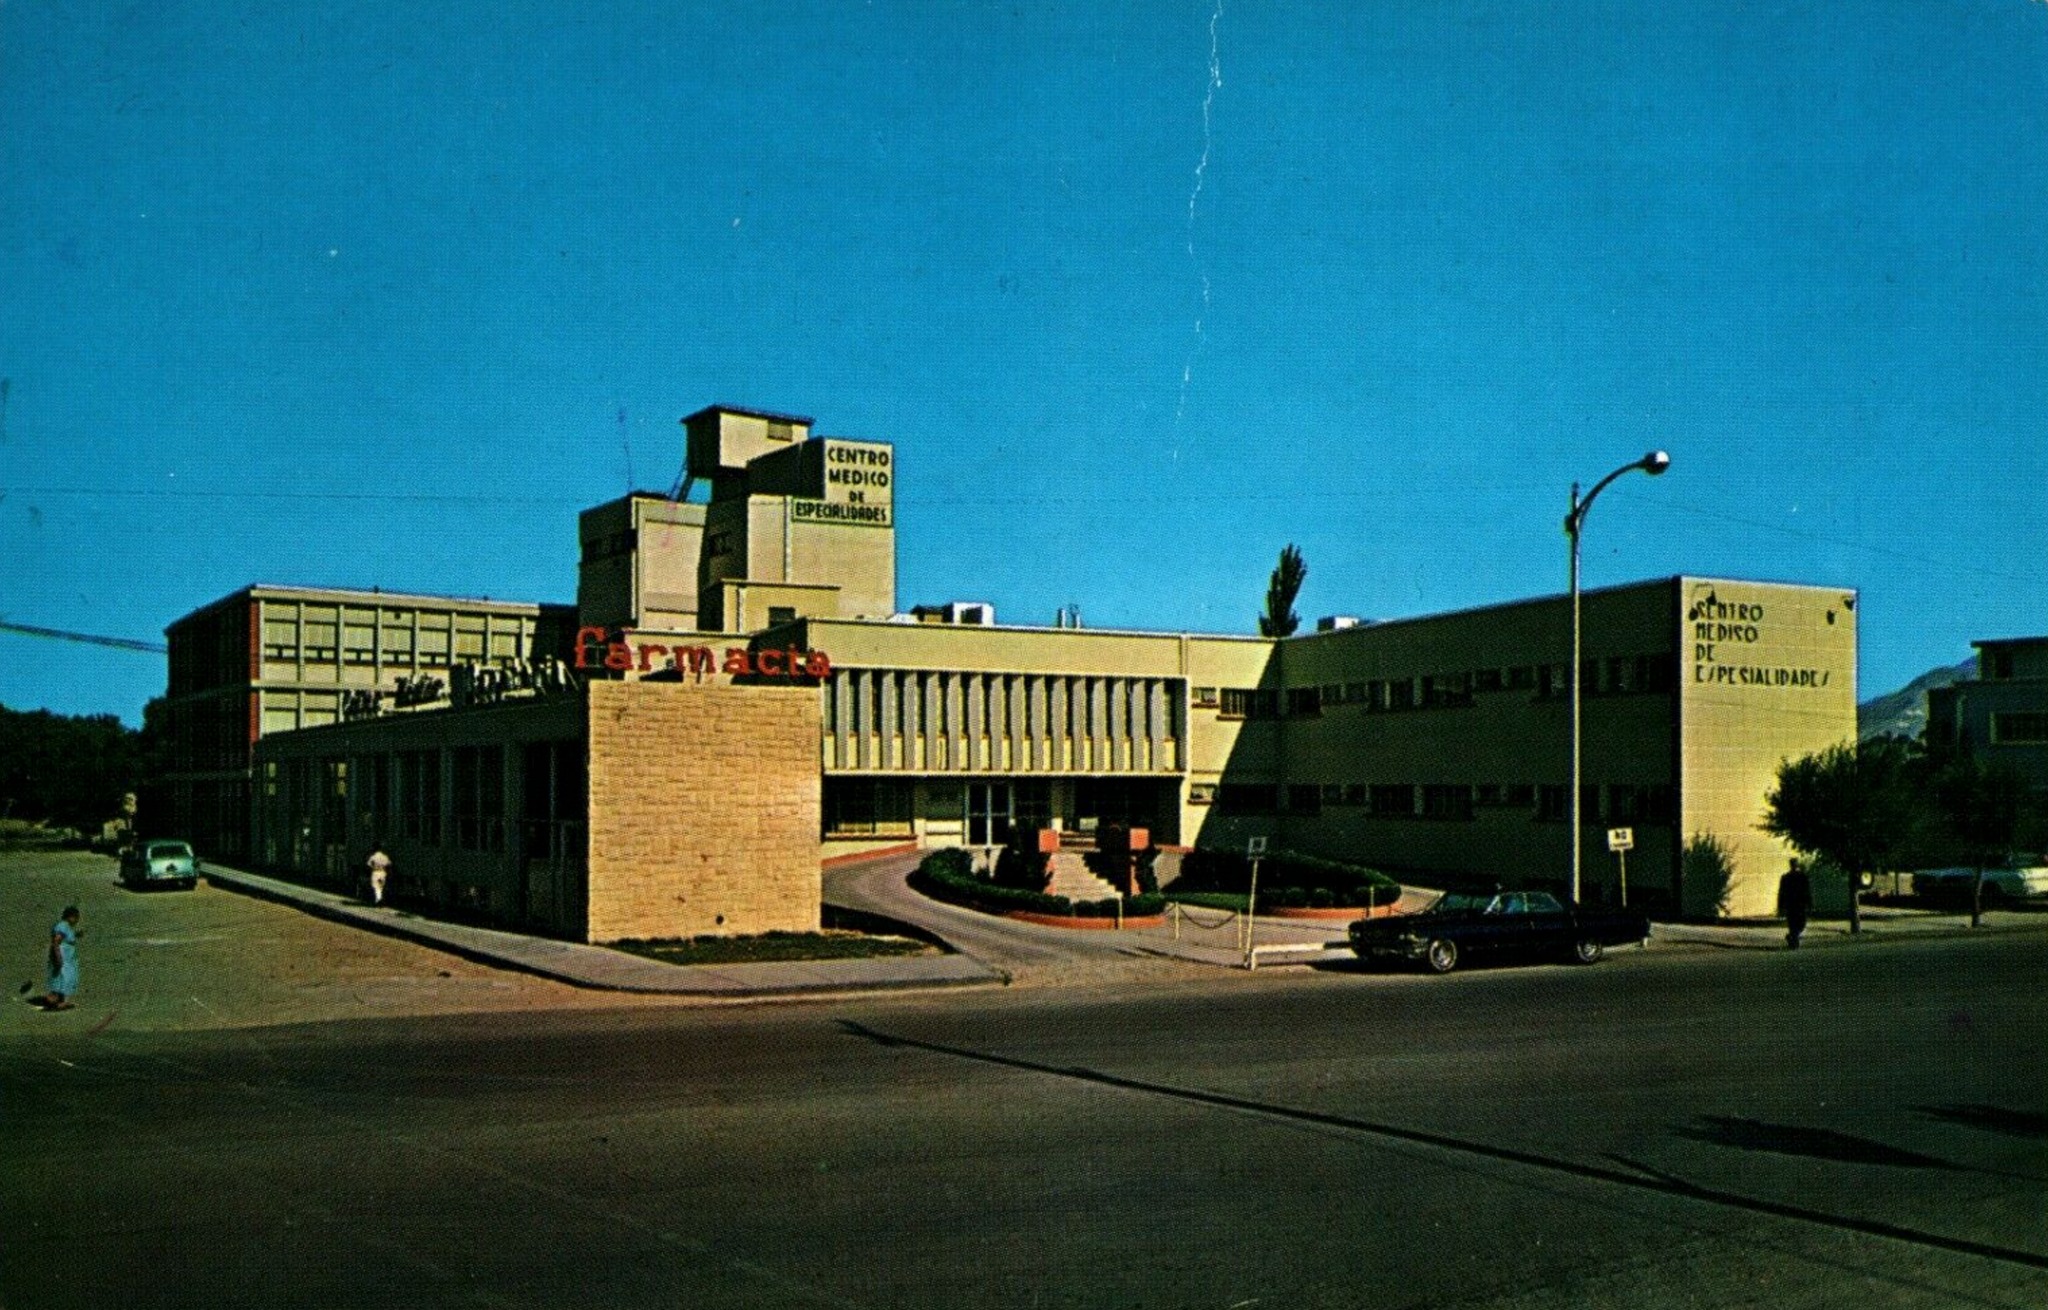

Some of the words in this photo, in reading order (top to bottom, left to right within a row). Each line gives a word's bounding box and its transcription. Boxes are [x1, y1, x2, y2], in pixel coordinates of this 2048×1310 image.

[828, 446, 889, 467] CENTRO
[828, 468, 888, 487] MEDICO
[849, 490, 864, 503] DE
[574, 626, 831, 679] farmacia
[1696, 643, 1715, 662] DE
